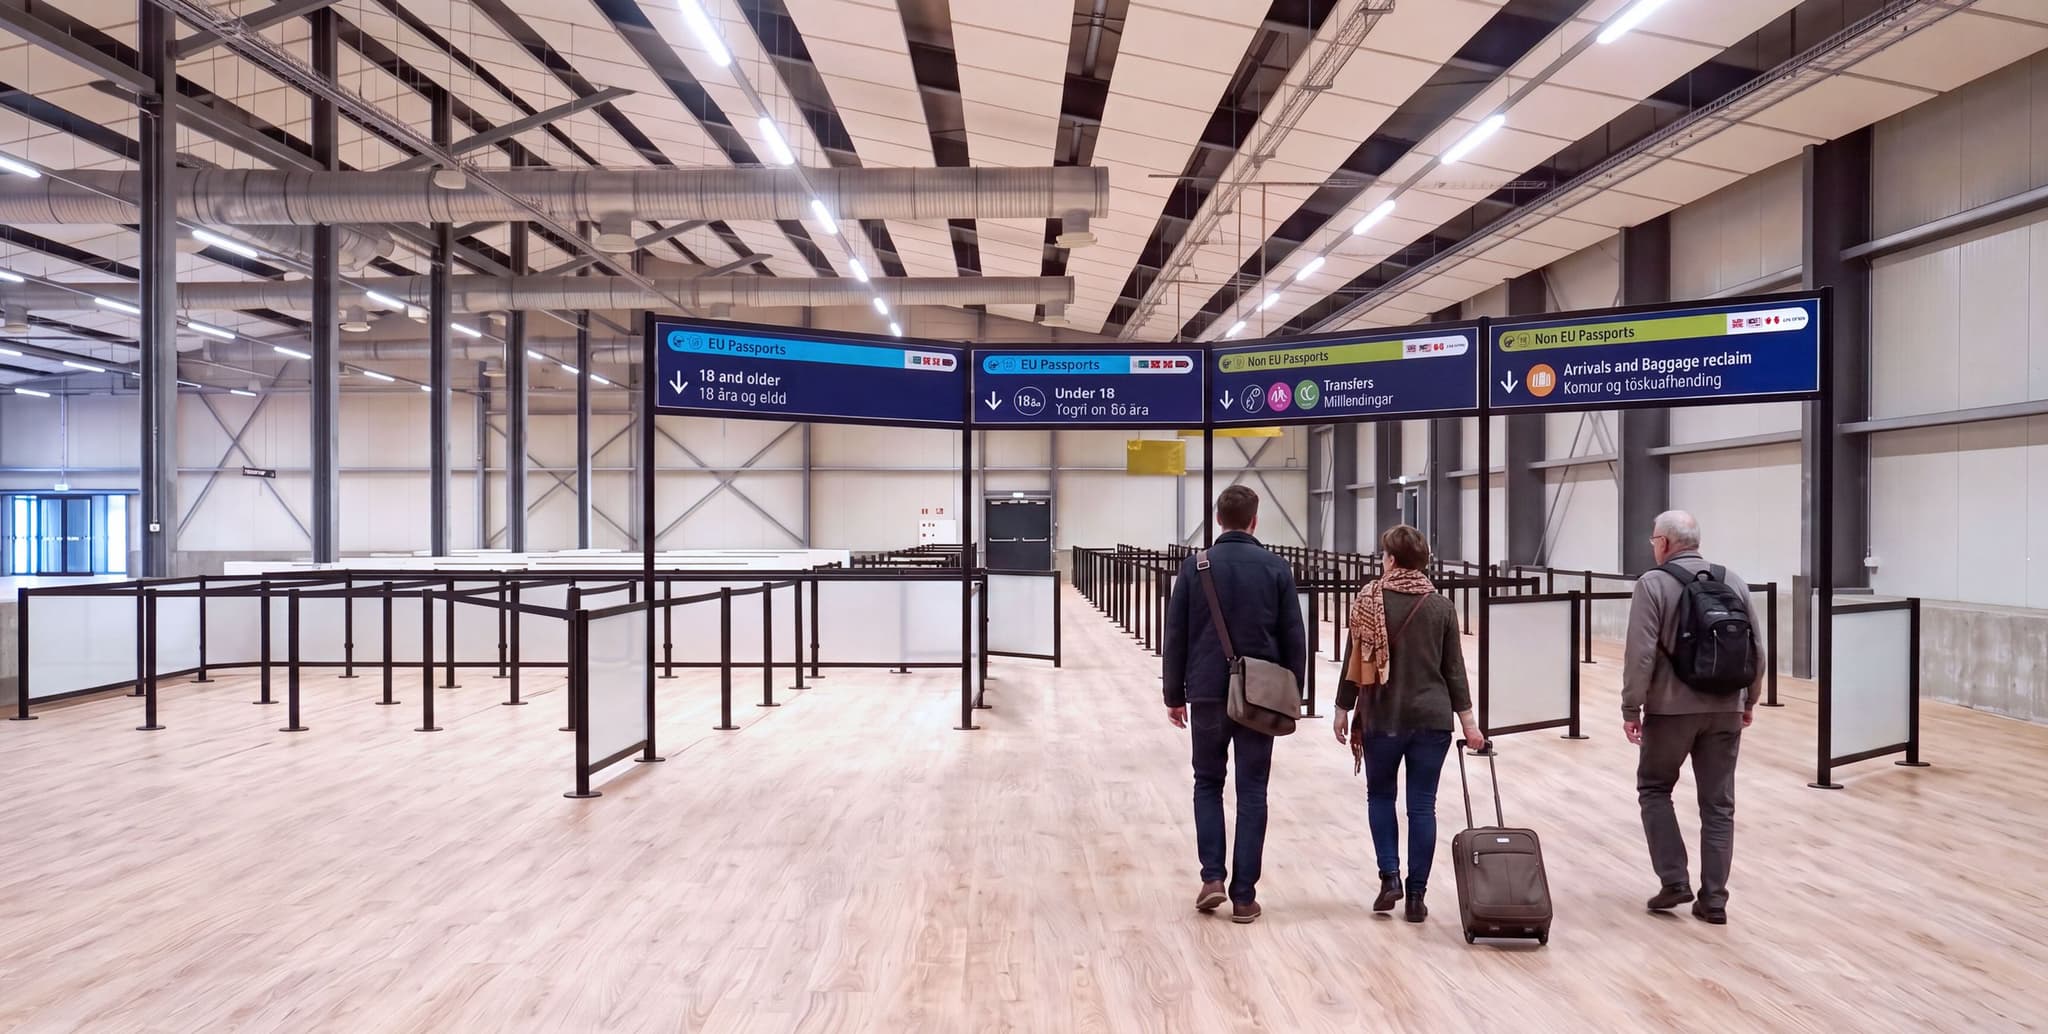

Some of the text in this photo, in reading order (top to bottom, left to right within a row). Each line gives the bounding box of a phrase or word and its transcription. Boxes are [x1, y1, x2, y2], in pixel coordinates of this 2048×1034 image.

[1535, 327, 1635, 345] Non EU Passports
[708, 337, 787, 356] EU Passports
[1021, 359, 1100, 373] EU Passports
[1248, 351, 1329, 367] Non EU Passports
[1564, 351, 1752, 376] Arrivals and Baggage reclaim
[699, 369, 781, 386] 18 and older
[1324, 377, 1374, 391] Transfers
[1606, 382, 1621, 395] og
[1625, 372, 1722, 391] töskuafhending
[699, 387, 714, 400] 18
[741, 391, 757, 407] og
[760, 390, 787, 405] eldd
[1055, 387, 1115, 399] Under 18
[1091, 405, 1106, 416] on
